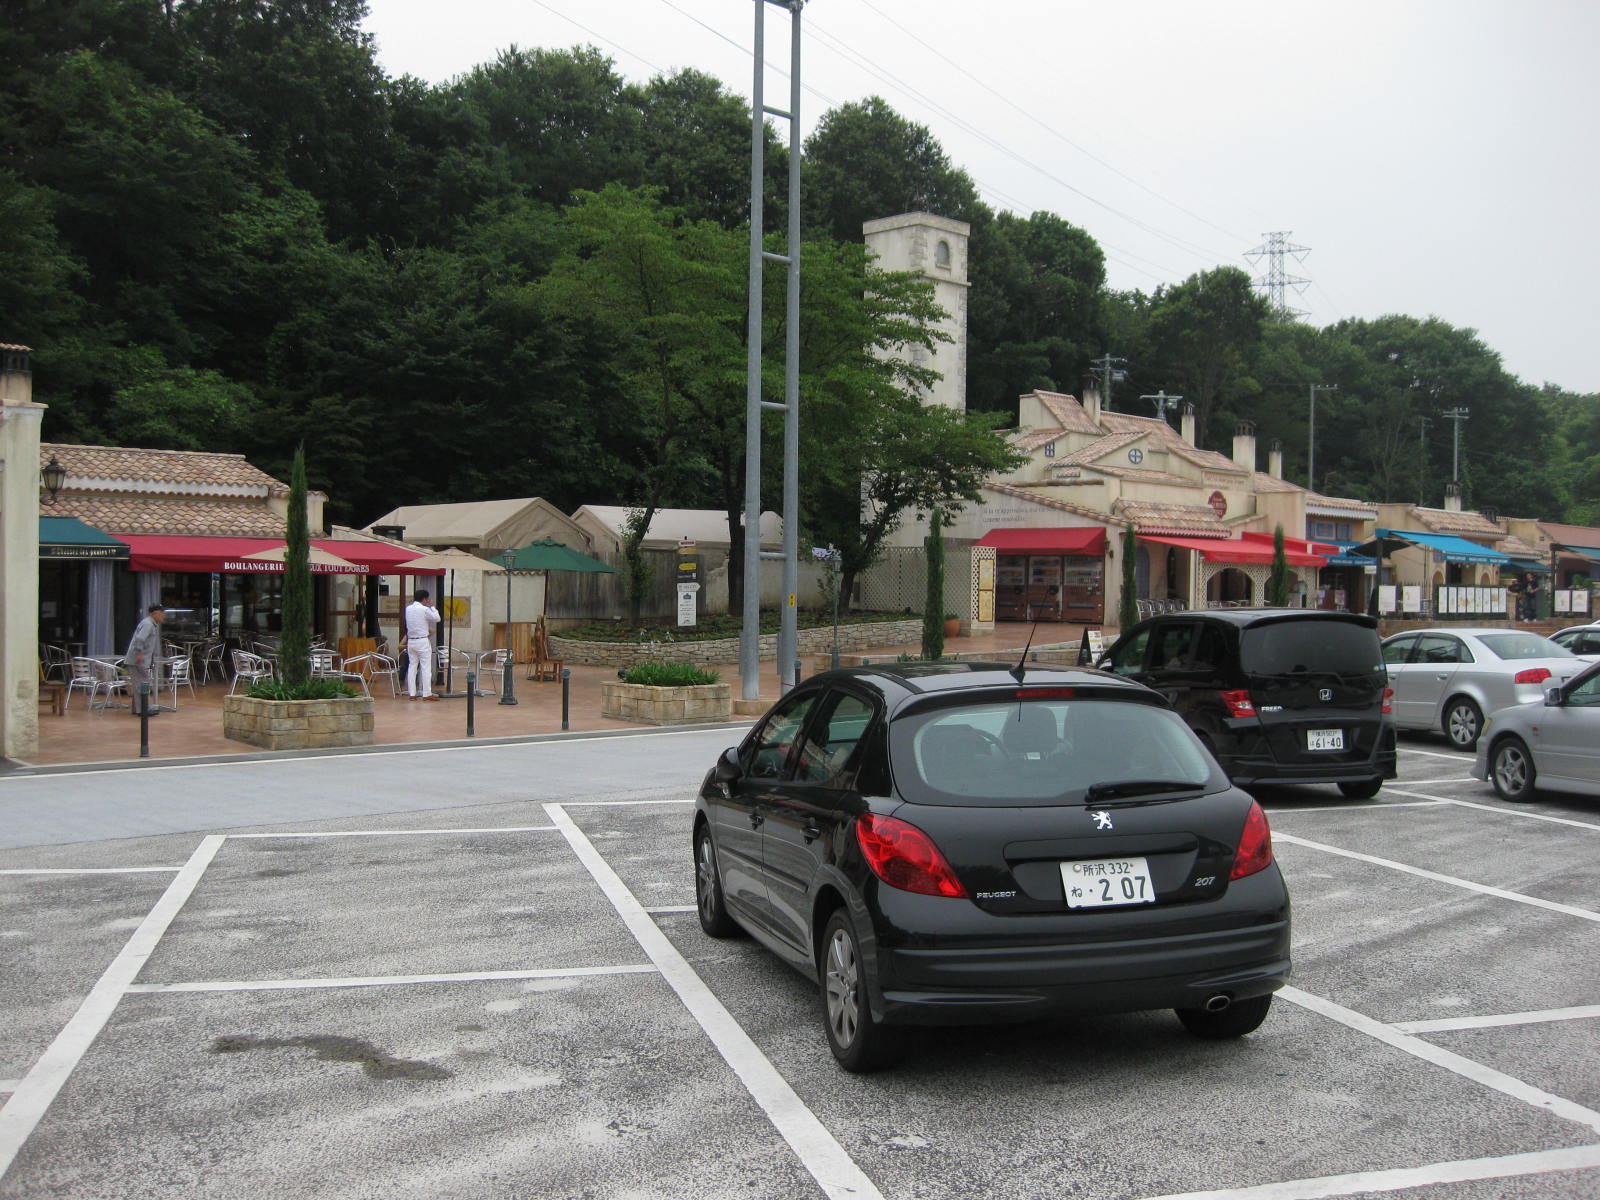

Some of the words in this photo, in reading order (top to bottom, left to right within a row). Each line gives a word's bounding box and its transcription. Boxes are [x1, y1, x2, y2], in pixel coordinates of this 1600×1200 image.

[224, 562, 284, 572] BOULANGERIE
[1316, 736, 1341, 748] 61-40
[1082, 864, 1107, 876] 所沢
[1108, 862, 1131, 874] 332
[1194, 876, 1216, 886] 207
[976, 890, 1016, 899] PEUGEOT
[1070, 886, 1082, 898] ね
